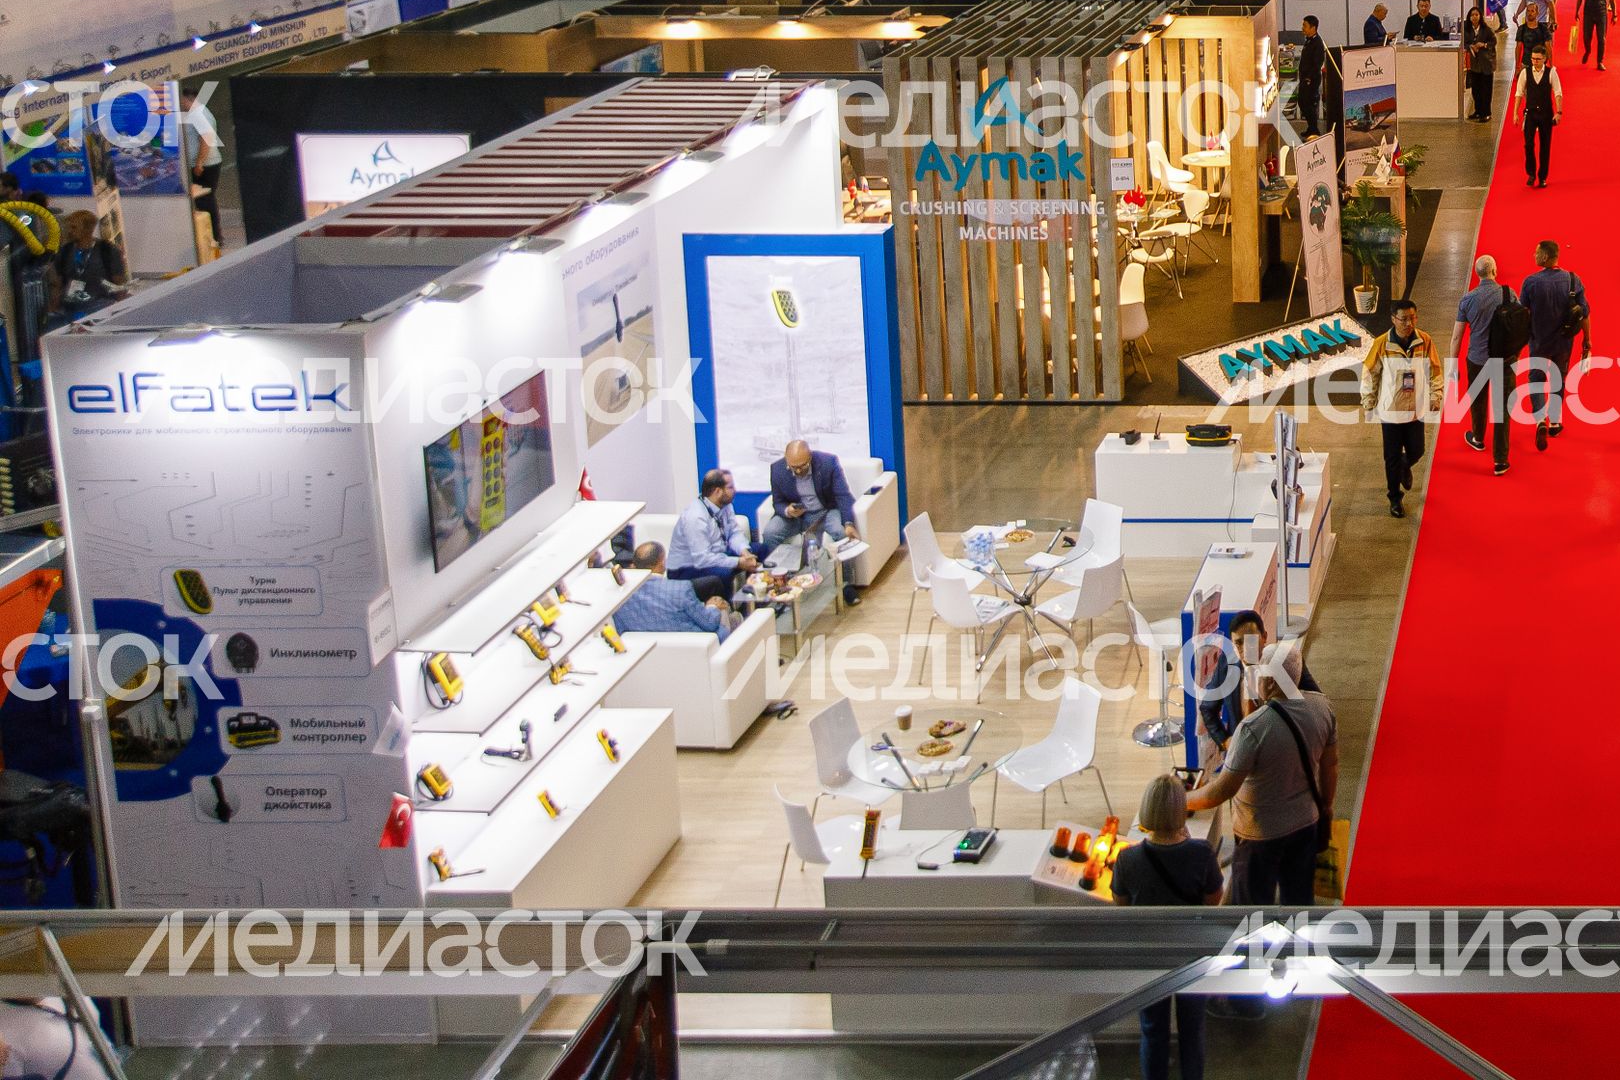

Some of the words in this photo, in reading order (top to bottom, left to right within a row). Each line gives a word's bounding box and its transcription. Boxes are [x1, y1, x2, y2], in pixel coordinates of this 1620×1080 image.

[214, 28, 268, 53] GUANGZHOU
[269, 19, 306, 38] MINSHUN
[189, 49, 240, 73] MACHINERY
[242, 37, 290, 58] EQUIPMENT
[1356, 66, 1384, 80] Aymak
[23, 86, 91, 116] International
[141, 64, 172, 82] Export
[914, 140, 1086, 191] Aymak
[1306, 157, 1327, 172] Aymak
[900, 200, 988, 217] CRUSHING
[993, 201, 1006, 216] &
[1009, 200, 1105, 217] SCREENING
[959, 225, 1048, 241] MACHINES
[1218, 318, 1361, 381] AYMAK
[136, 427, 153, 436] для
[286, 426, 352, 436] оборудования
[241, 586, 316, 596] дистанционного
[238, 597, 293, 607] управления
[270, 647, 358, 660] Инклинометр
[290, 716, 366, 729] Мобильный
[292, 733, 367, 744] контроллер
[265, 786, 327, 799] Оператор
[264, 799, 332, 813] джойстика
